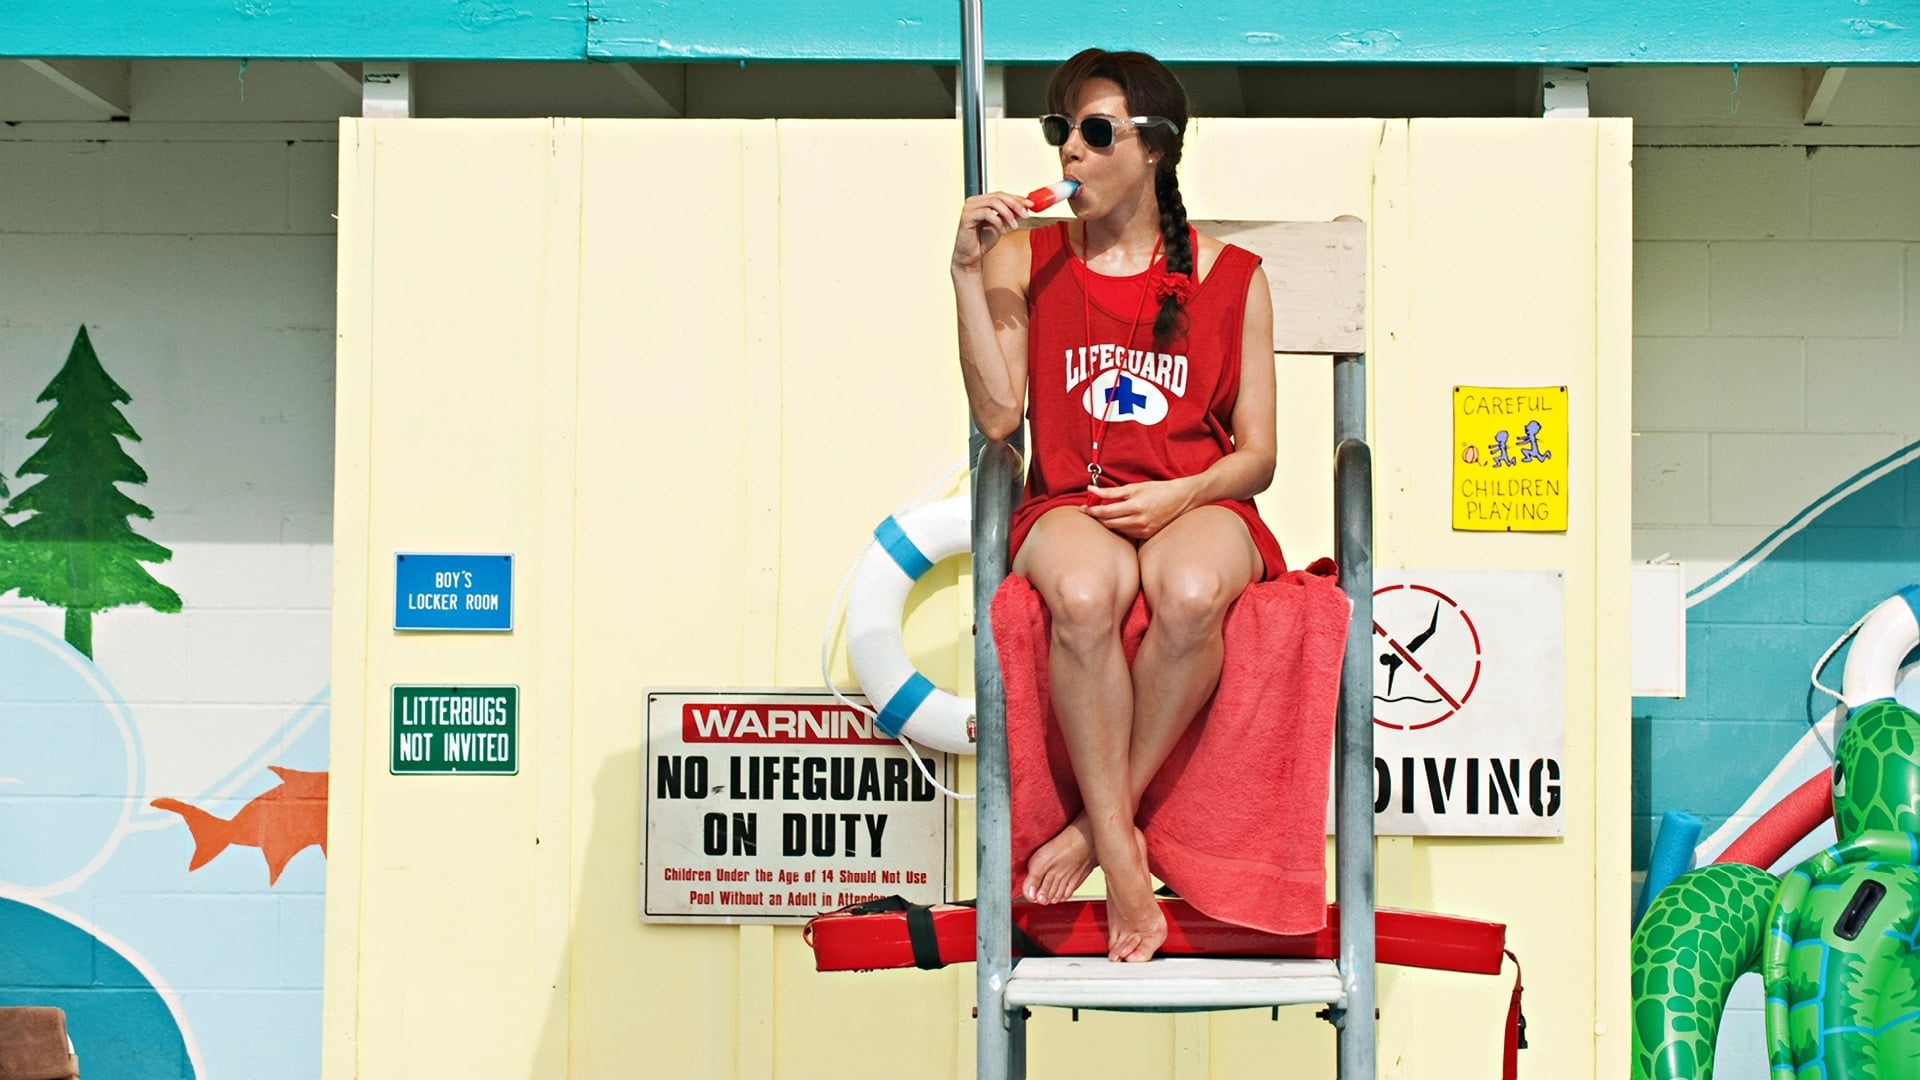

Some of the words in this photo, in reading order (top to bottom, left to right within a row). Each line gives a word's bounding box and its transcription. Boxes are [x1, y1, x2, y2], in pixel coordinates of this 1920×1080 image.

[1065, 344, 1188, 398] LIFEGUARD
[1463, 395, 1552, 416] CAREFUL
[1461, 478, 1559, 497] CHILDREN
[1466, 501, 1549, 521] PLAYING
[435, 570, 472, 588] BOY'S
[408, 593, 458, 610] LOCKER
[466, 594, 499, 611] ROOM
[402, 696, 507, 725] LITTERBUGS
[400, 732, 433, 762] NOT
[444, 732, 509, 762] INVITED
[657, 755, 709, 799] NO
[730, 756, 936, 802] LIFEGUARD
[703, 812, 757, 856] ON
[782, 812, 888, 858] DUTY
[664, 868, 711, 881] Children
[716, 868, 750, 881] Under
[755, 869, 773, 882] the
[778, 869, 799, 885] Age
[804, 870, 816, 883] of
[822, 870, 834, 883] 14
[840, 870, 876, 884] Should
[881, 870, 901, 884] Not
[906, 871, 927, 884] Use
[690, 891, 714, 905] Pool
[720, 891, 763, 906] Without
[769, 894, 782, 906] an
[788, 892, 816, 906] Adult
[822, 892, 832, 906] in
